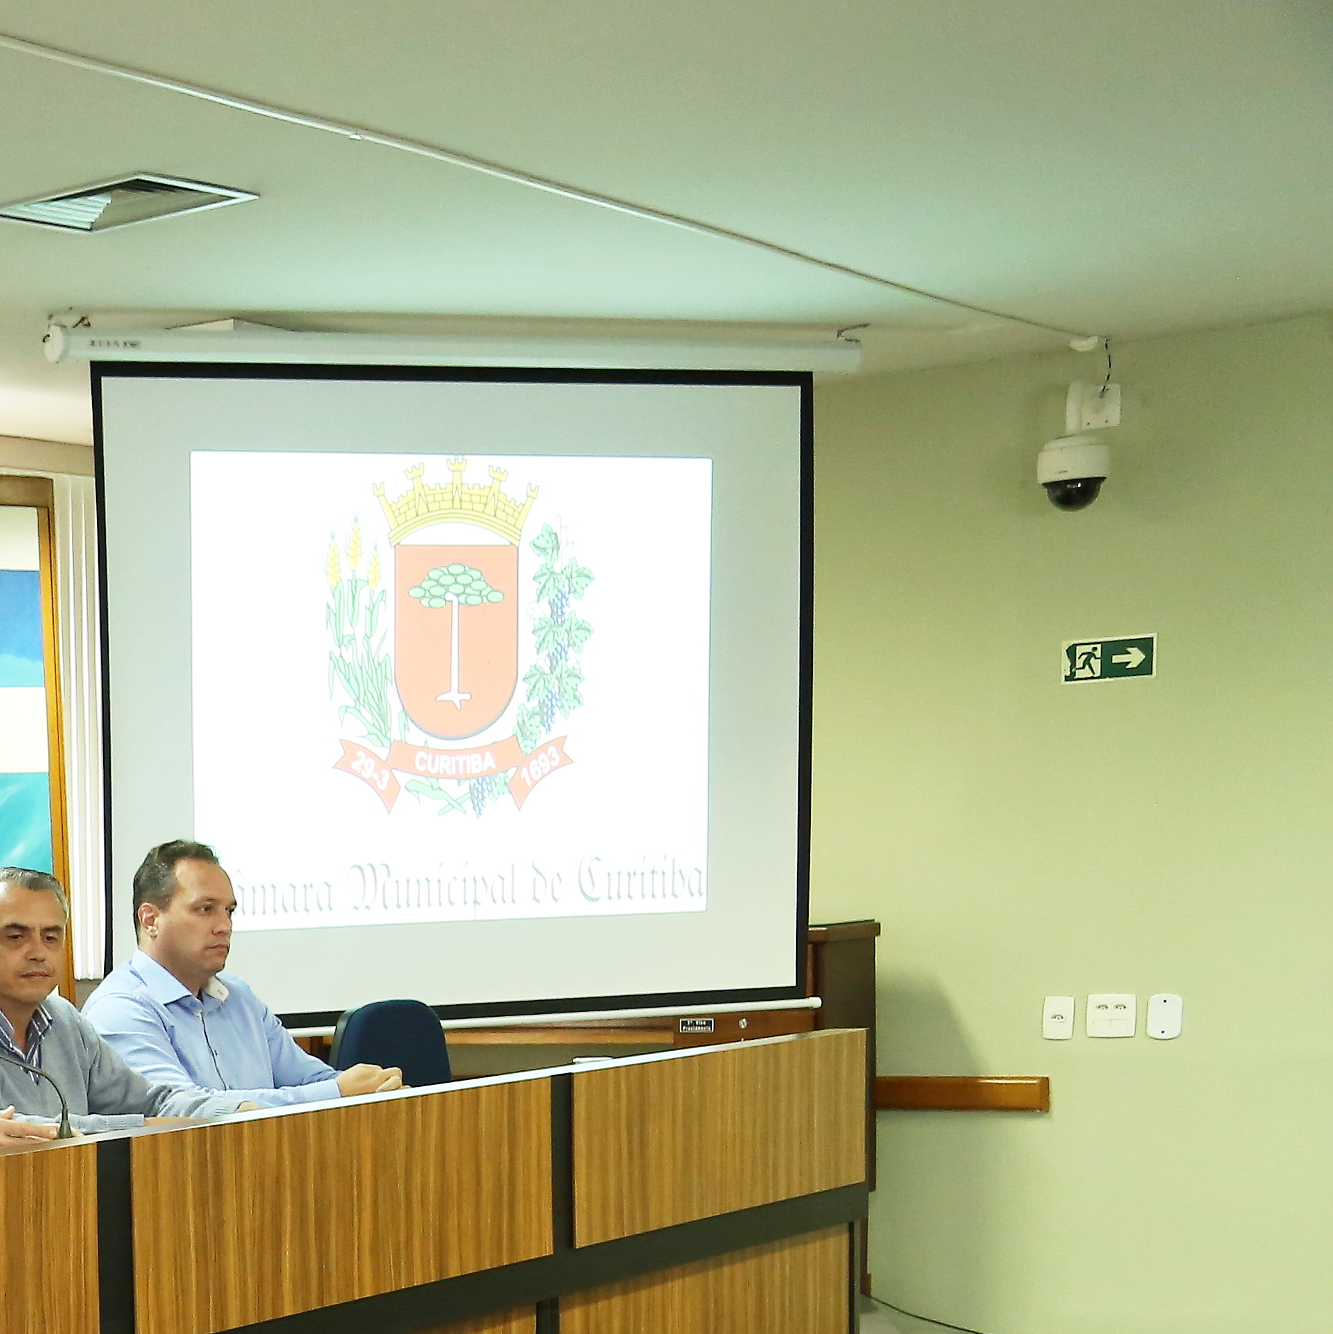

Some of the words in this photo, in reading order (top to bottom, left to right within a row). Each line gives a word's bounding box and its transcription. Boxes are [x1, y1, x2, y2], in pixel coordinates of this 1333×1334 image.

[350, 750, 390, 791] 29-3
[414, 750, 497, 775] CURITIBA
[520, 745, 561, 787] 1693
[233, 869, 333, 917] âmara
[348, 860, 517, 921] Municipal
[532, 860, 562, 905] de
[578, 855, 704, 903] Curitiba
